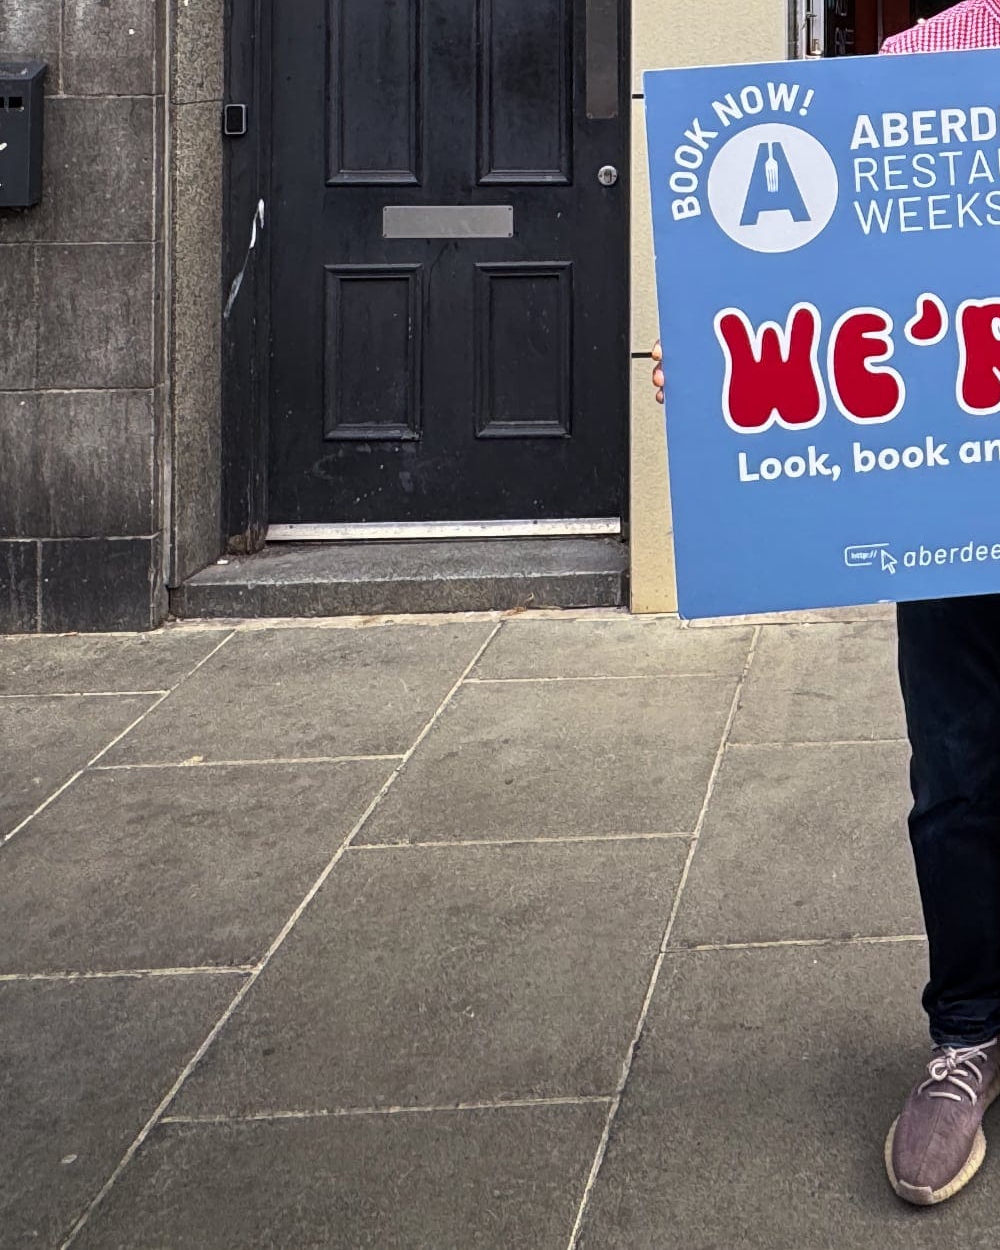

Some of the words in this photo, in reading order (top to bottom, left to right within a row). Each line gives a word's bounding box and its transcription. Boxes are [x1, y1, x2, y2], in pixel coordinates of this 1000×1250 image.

[669, 116, 720, 221] BOOK
[711, 82, 815, 126] NOW!
[738, 450, 842, 483] Look,
[853, 437, 950, 473] book
